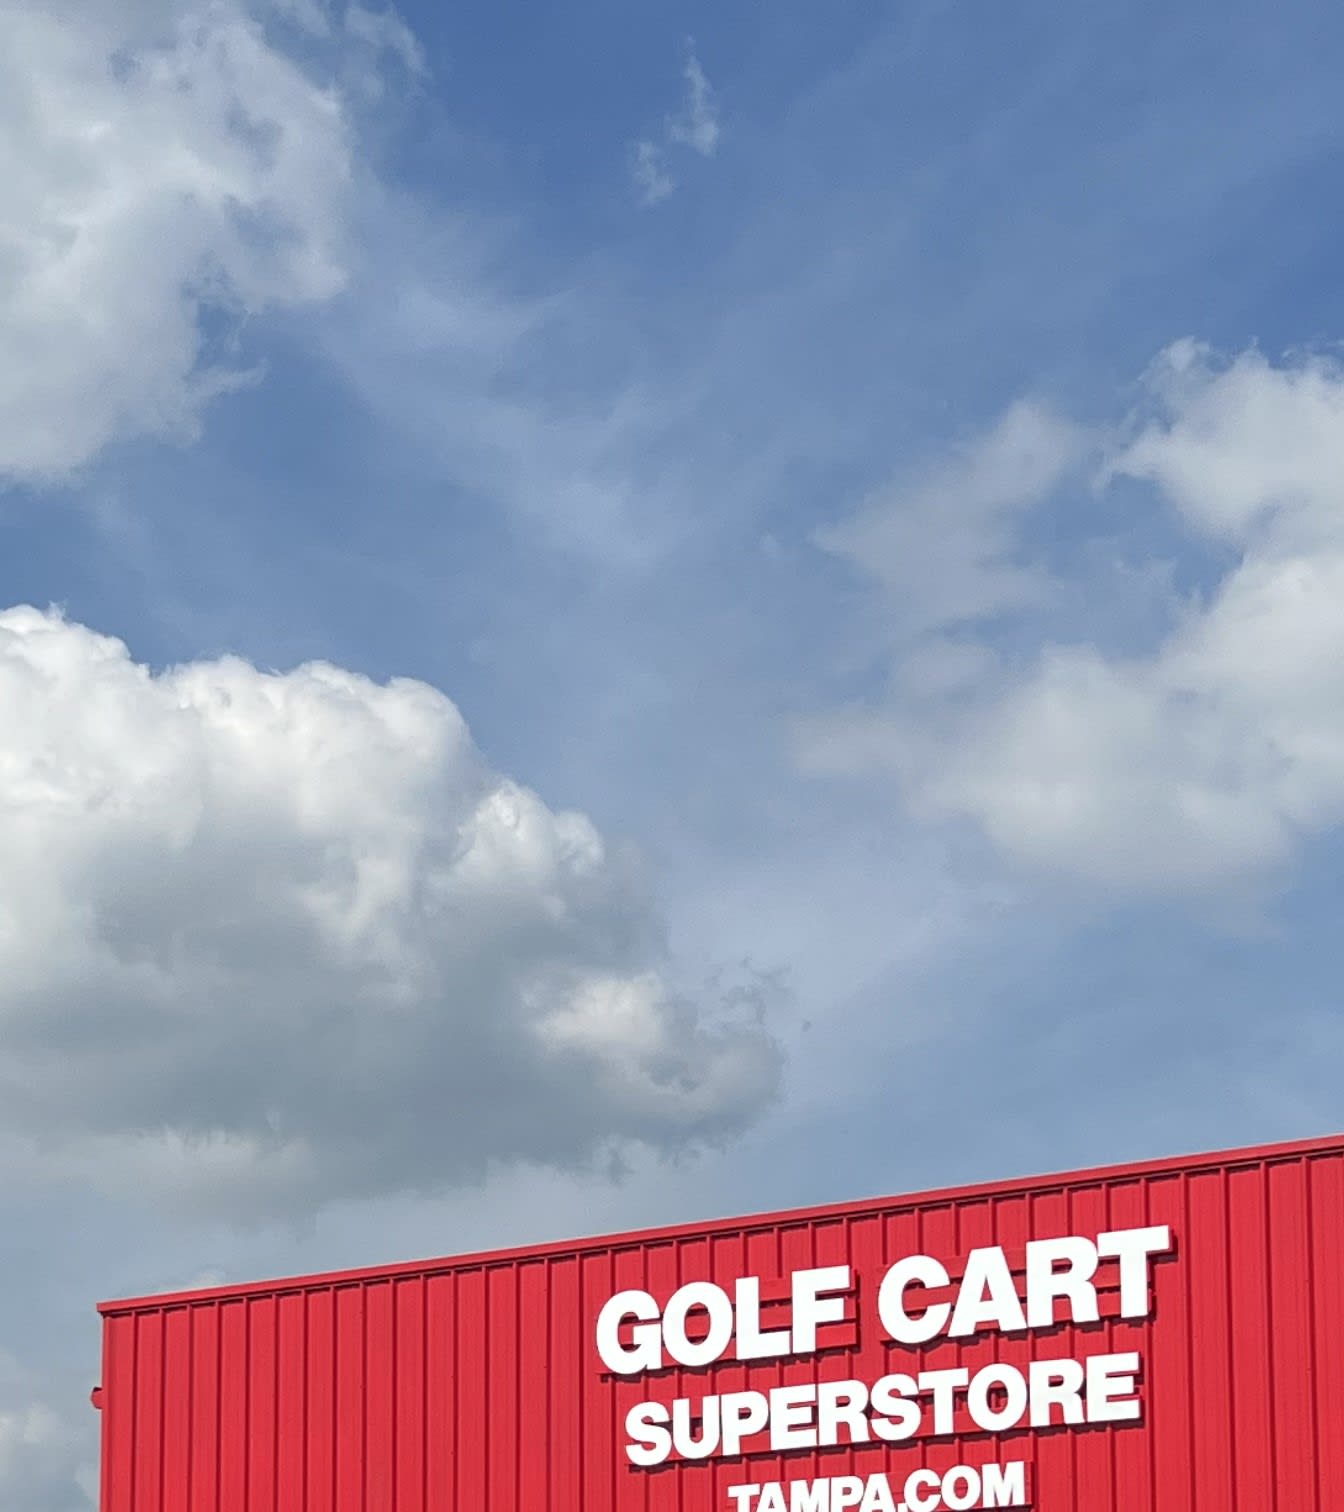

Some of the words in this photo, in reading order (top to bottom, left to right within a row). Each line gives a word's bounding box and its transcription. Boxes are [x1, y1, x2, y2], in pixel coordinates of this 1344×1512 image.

[596, 1265, 851, 1375] GOLF
[877, 1225, 1171, 1345] CART
[625, 1351, 1140, 1466] SUPERSTORE
